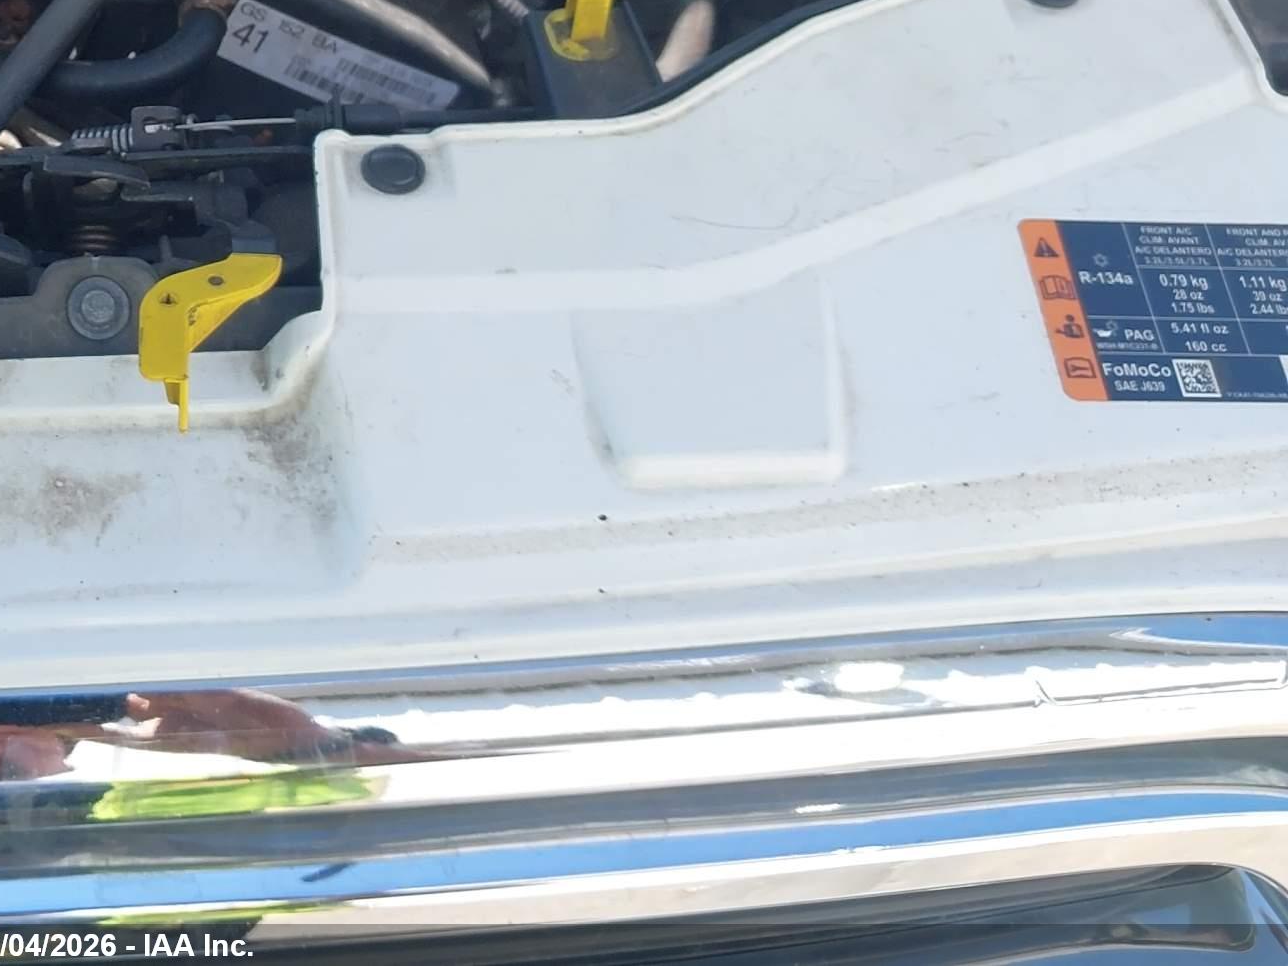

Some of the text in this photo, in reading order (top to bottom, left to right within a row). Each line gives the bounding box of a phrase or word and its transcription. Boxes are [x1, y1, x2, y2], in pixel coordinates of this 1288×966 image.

[232, 23, 270, 54] 41
[1140, 226, 1172, 235] FRONT
[1167, 236, 1199, 245] AVANT
[1153, 246, 1212, 255] DELANTERO
[1078, 270, 1134, 285] R-134a
[1159, 273, 1209, 291] 0.79 kg
[1239, 275, 1287, 292] 1.11 kg
[1172, 288, 1205, 301] 28 oz
[1171, 301, 1215, 314] 1.75 lbs
[1249, 303, 1274, 315] 2.44
[1124, 328, 1155, 341] PAG
[1170, 322, 1230, 335] 5.41 fl oz
[1184, 340, 1228, 352] 160 cc
[1102, 362, 1172, 378] FoMoCo
[1114, 379, 1139, 392] SAE
